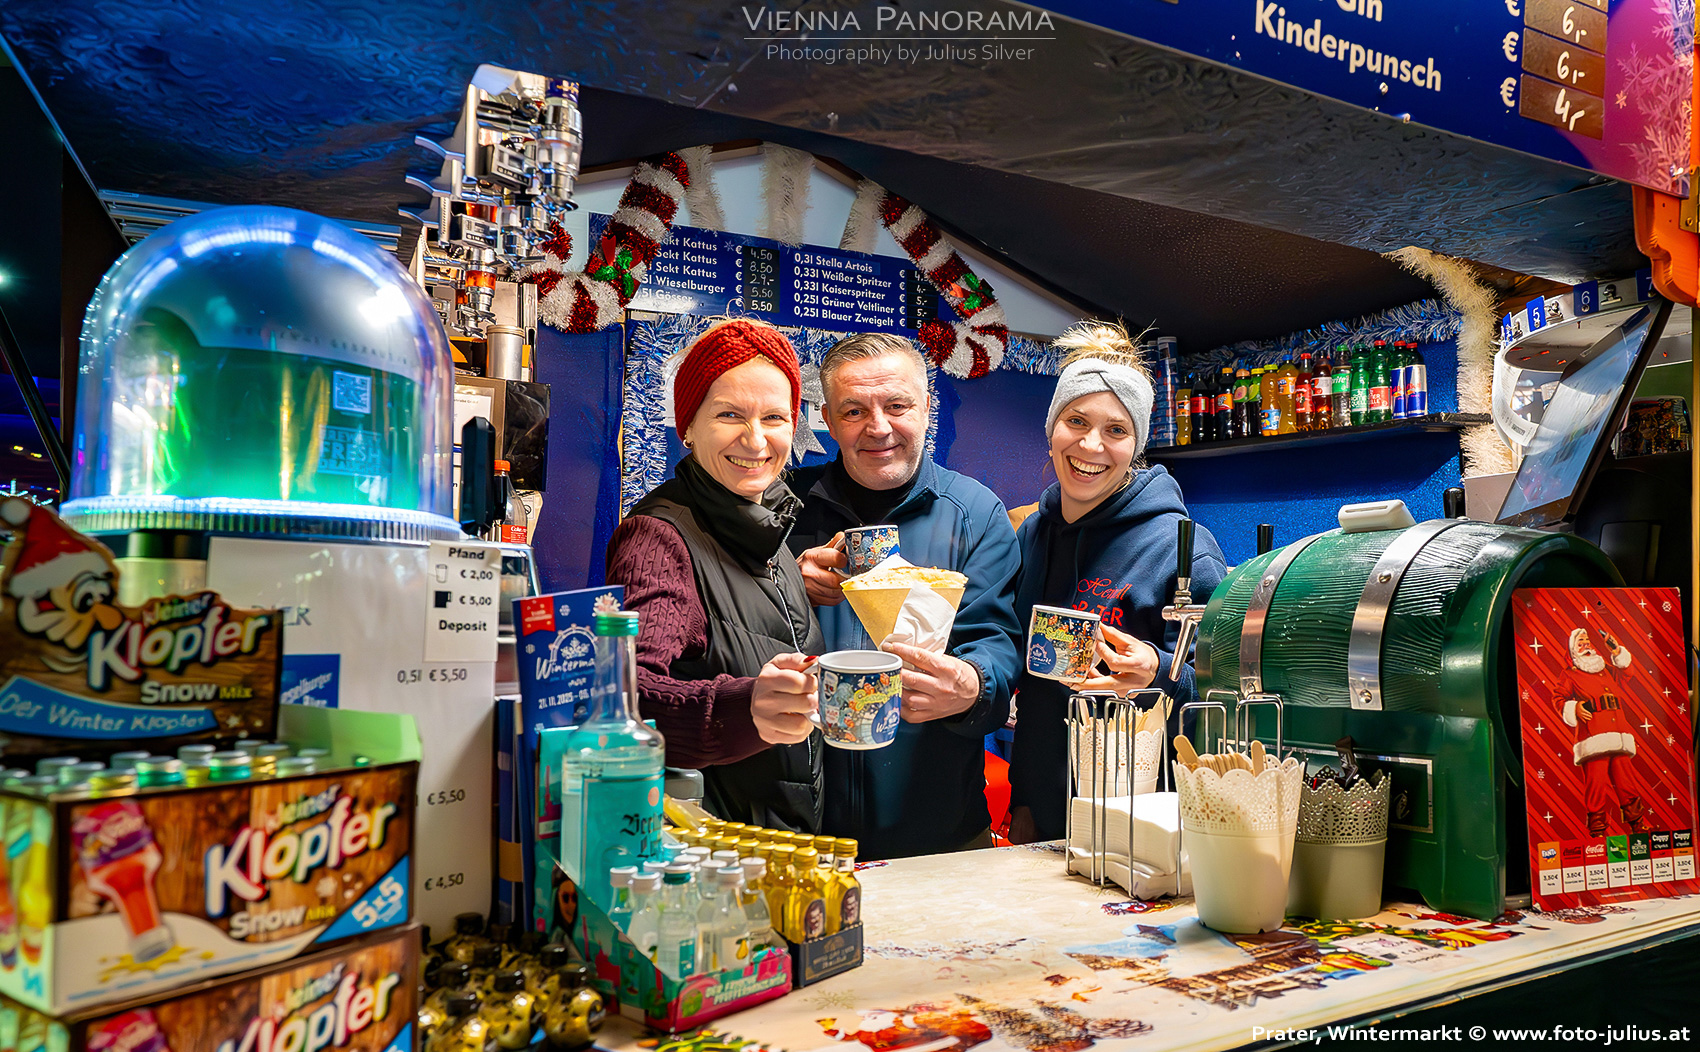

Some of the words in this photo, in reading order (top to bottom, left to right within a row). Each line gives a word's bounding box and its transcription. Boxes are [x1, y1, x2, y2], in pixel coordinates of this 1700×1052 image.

[1255, 0, 1442, 92] Kinderpunsch
[1500, 77, 1517, 108] €
[1502, 31, 1519, 62] €
[683, 238, 717, 251] Kattus
[735, 245, 742, 255] €
[656, 249, 679, 260] Sekt
[683, 251, 717, 265] Kattus
[735, 258, 742, 268] €
[750, 262, 773, 274] 8.50
[816, 255, 842, 268] Stella
[845, 262, 873, 273] Artois
[899, 270, 905, 279] €
[656, 262, 679, 274] Sekt
[683, 265, 717, 278] Kattus
[735, 271, 742, 281] €
[821, 270, 854, 283] Weißer
[856, 275, 892, 289] Spritzer
[899, 282, 905, 291] €
[656, 275, 725, 294] Wieselburger
[735, 284, 742, 294] €
[821, 283, 886, 300] Kaiserspritzer
[899, 294, 905, 303] €
[750, 300, 773, 311] 5.50
[821, 296, 855, 309] Grüner
[857, 301, 895, 314] Veltliner
[899, 306, 905, 315] €
[1581, 290, 1590, 305] 6
[821, 309, 852, 322] Blauer
[855, 313, 894, 328] Zweigelt
[899, 318, 905, 327] €
[1532, 307, 1540, 322] 5
[448, 547, 485, 560] Pfand
[470, 570, 494, 581] 2,00
[469, 596, 492, 607] 5,00
[439, 620, 487, 633] Deposit
[88, 606, 269, 690] Klopfer
[440, 668, 468, 683] 5,50
[141, 681, 217, 704] Snow
[0, 693, 43, 718] Der
[49, 703, 124, 731] Winter
[130, 714, 205, 733] Klopfer
[427, 793, 435, 805] €
[438, 789, 466, 806] 5,50
[206, 796, 397, 918] Klopfer
[425, 878, 432, 891] €
[436, 872, 464, 889] 4,50
[230, 906, 306, 939] Snow
